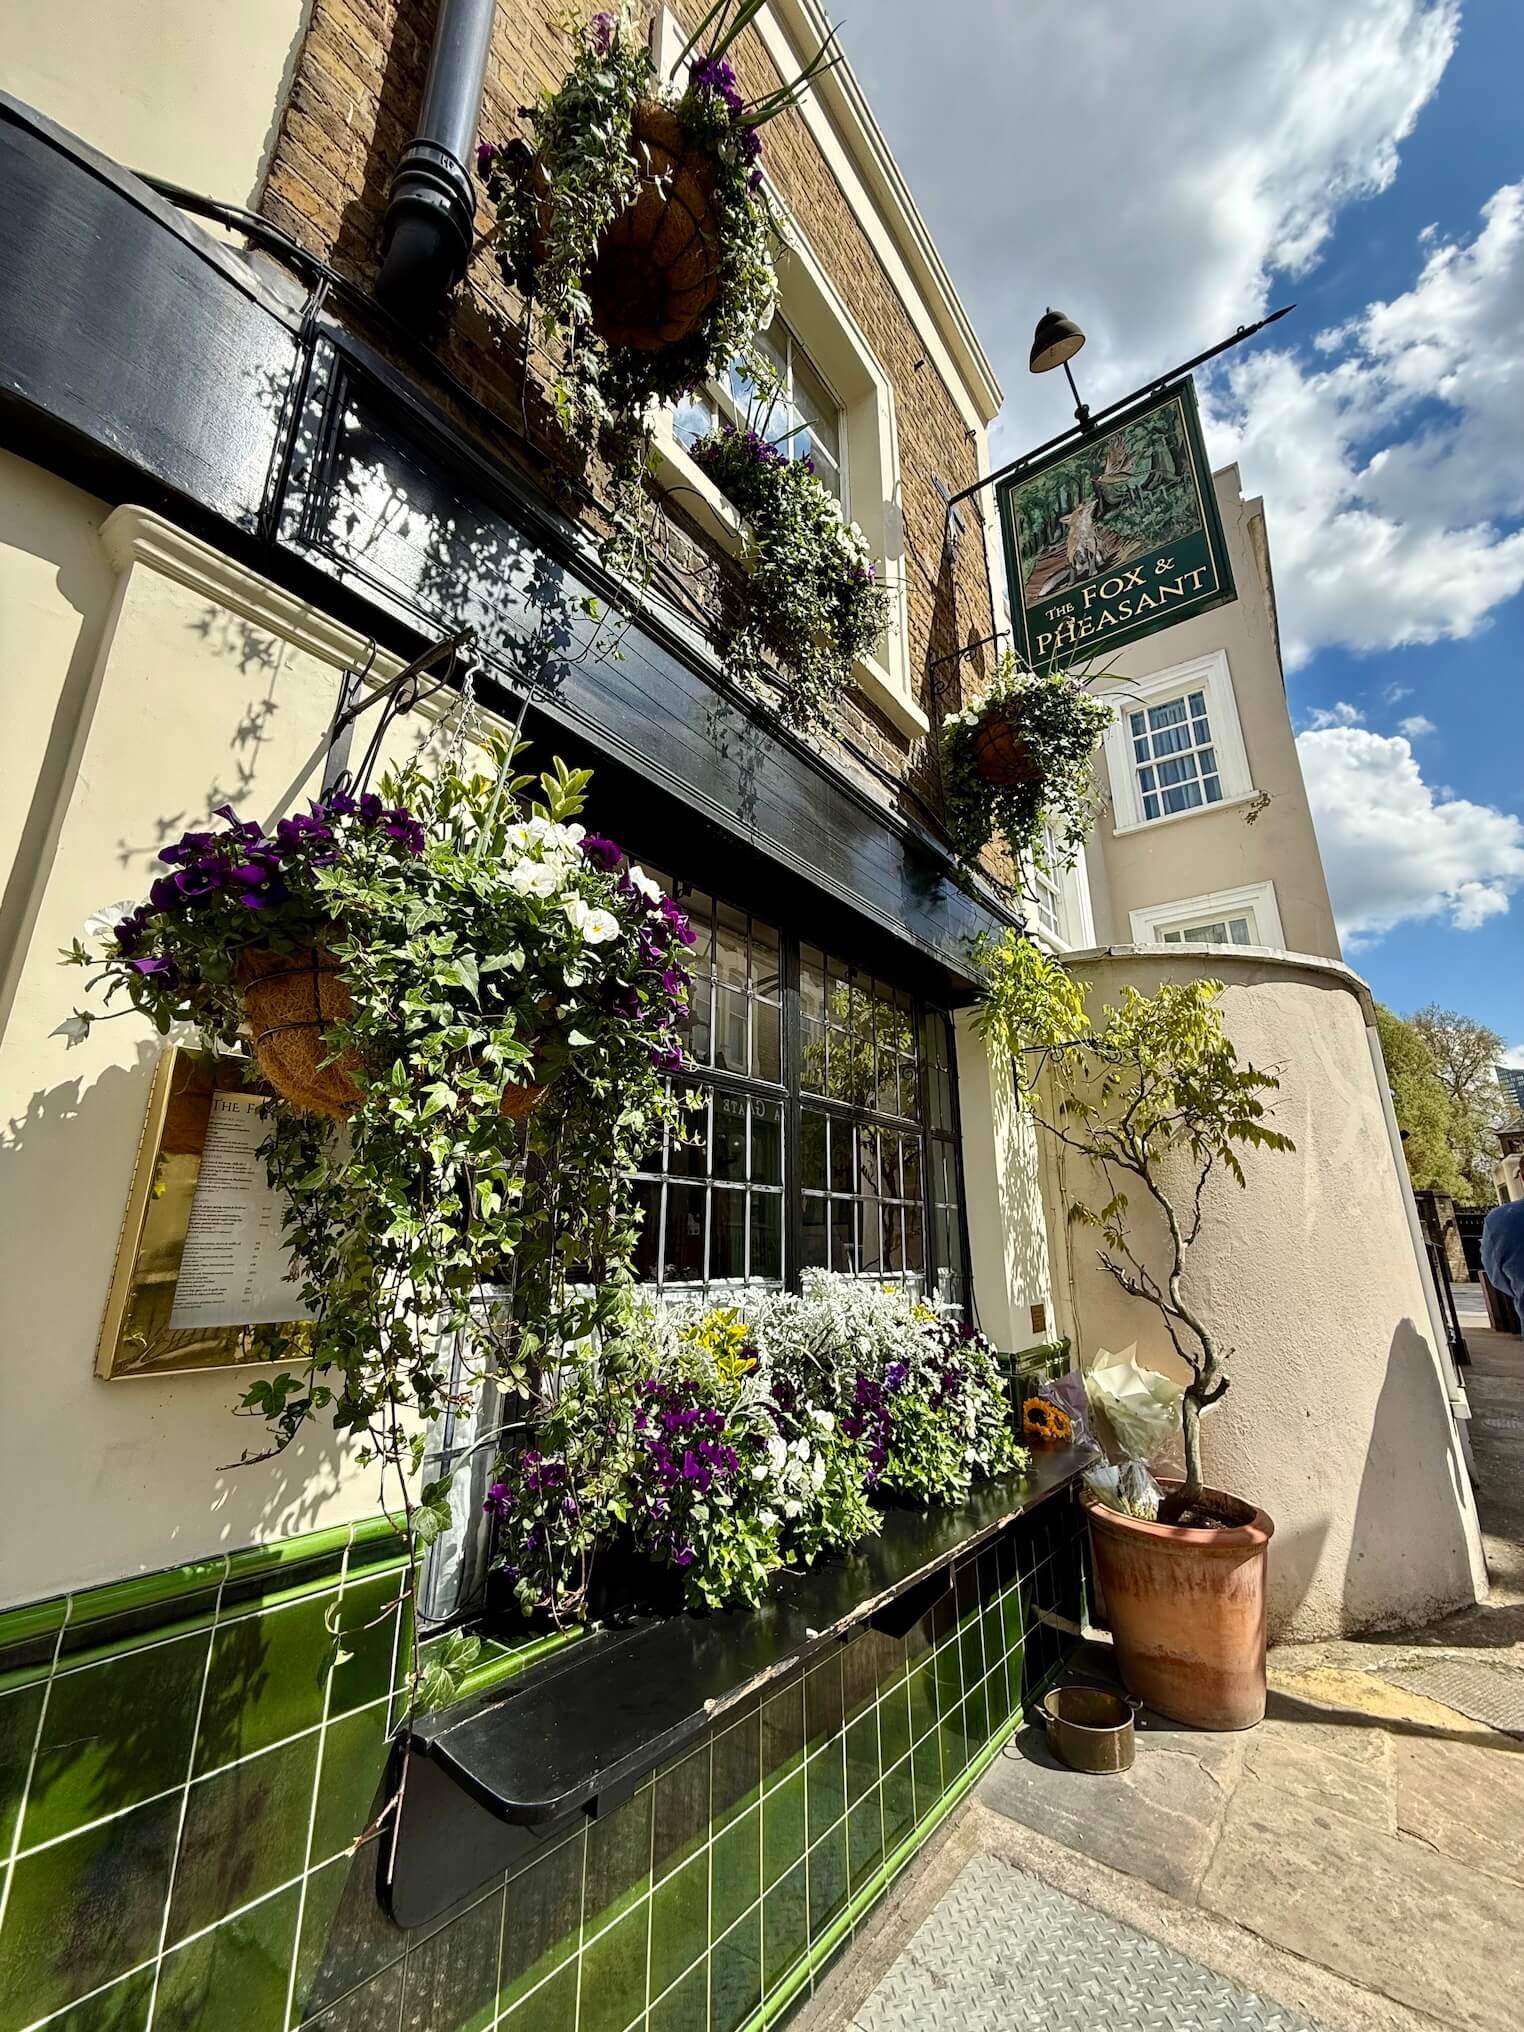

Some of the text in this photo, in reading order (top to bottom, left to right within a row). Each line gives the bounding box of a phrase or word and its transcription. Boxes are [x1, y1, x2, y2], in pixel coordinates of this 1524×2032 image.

[1036, 566, 1208, 656] PHEASANT
[1045, 557, 1176, 621] THE FOX &
[214, 1099, 241, 1113] THE
